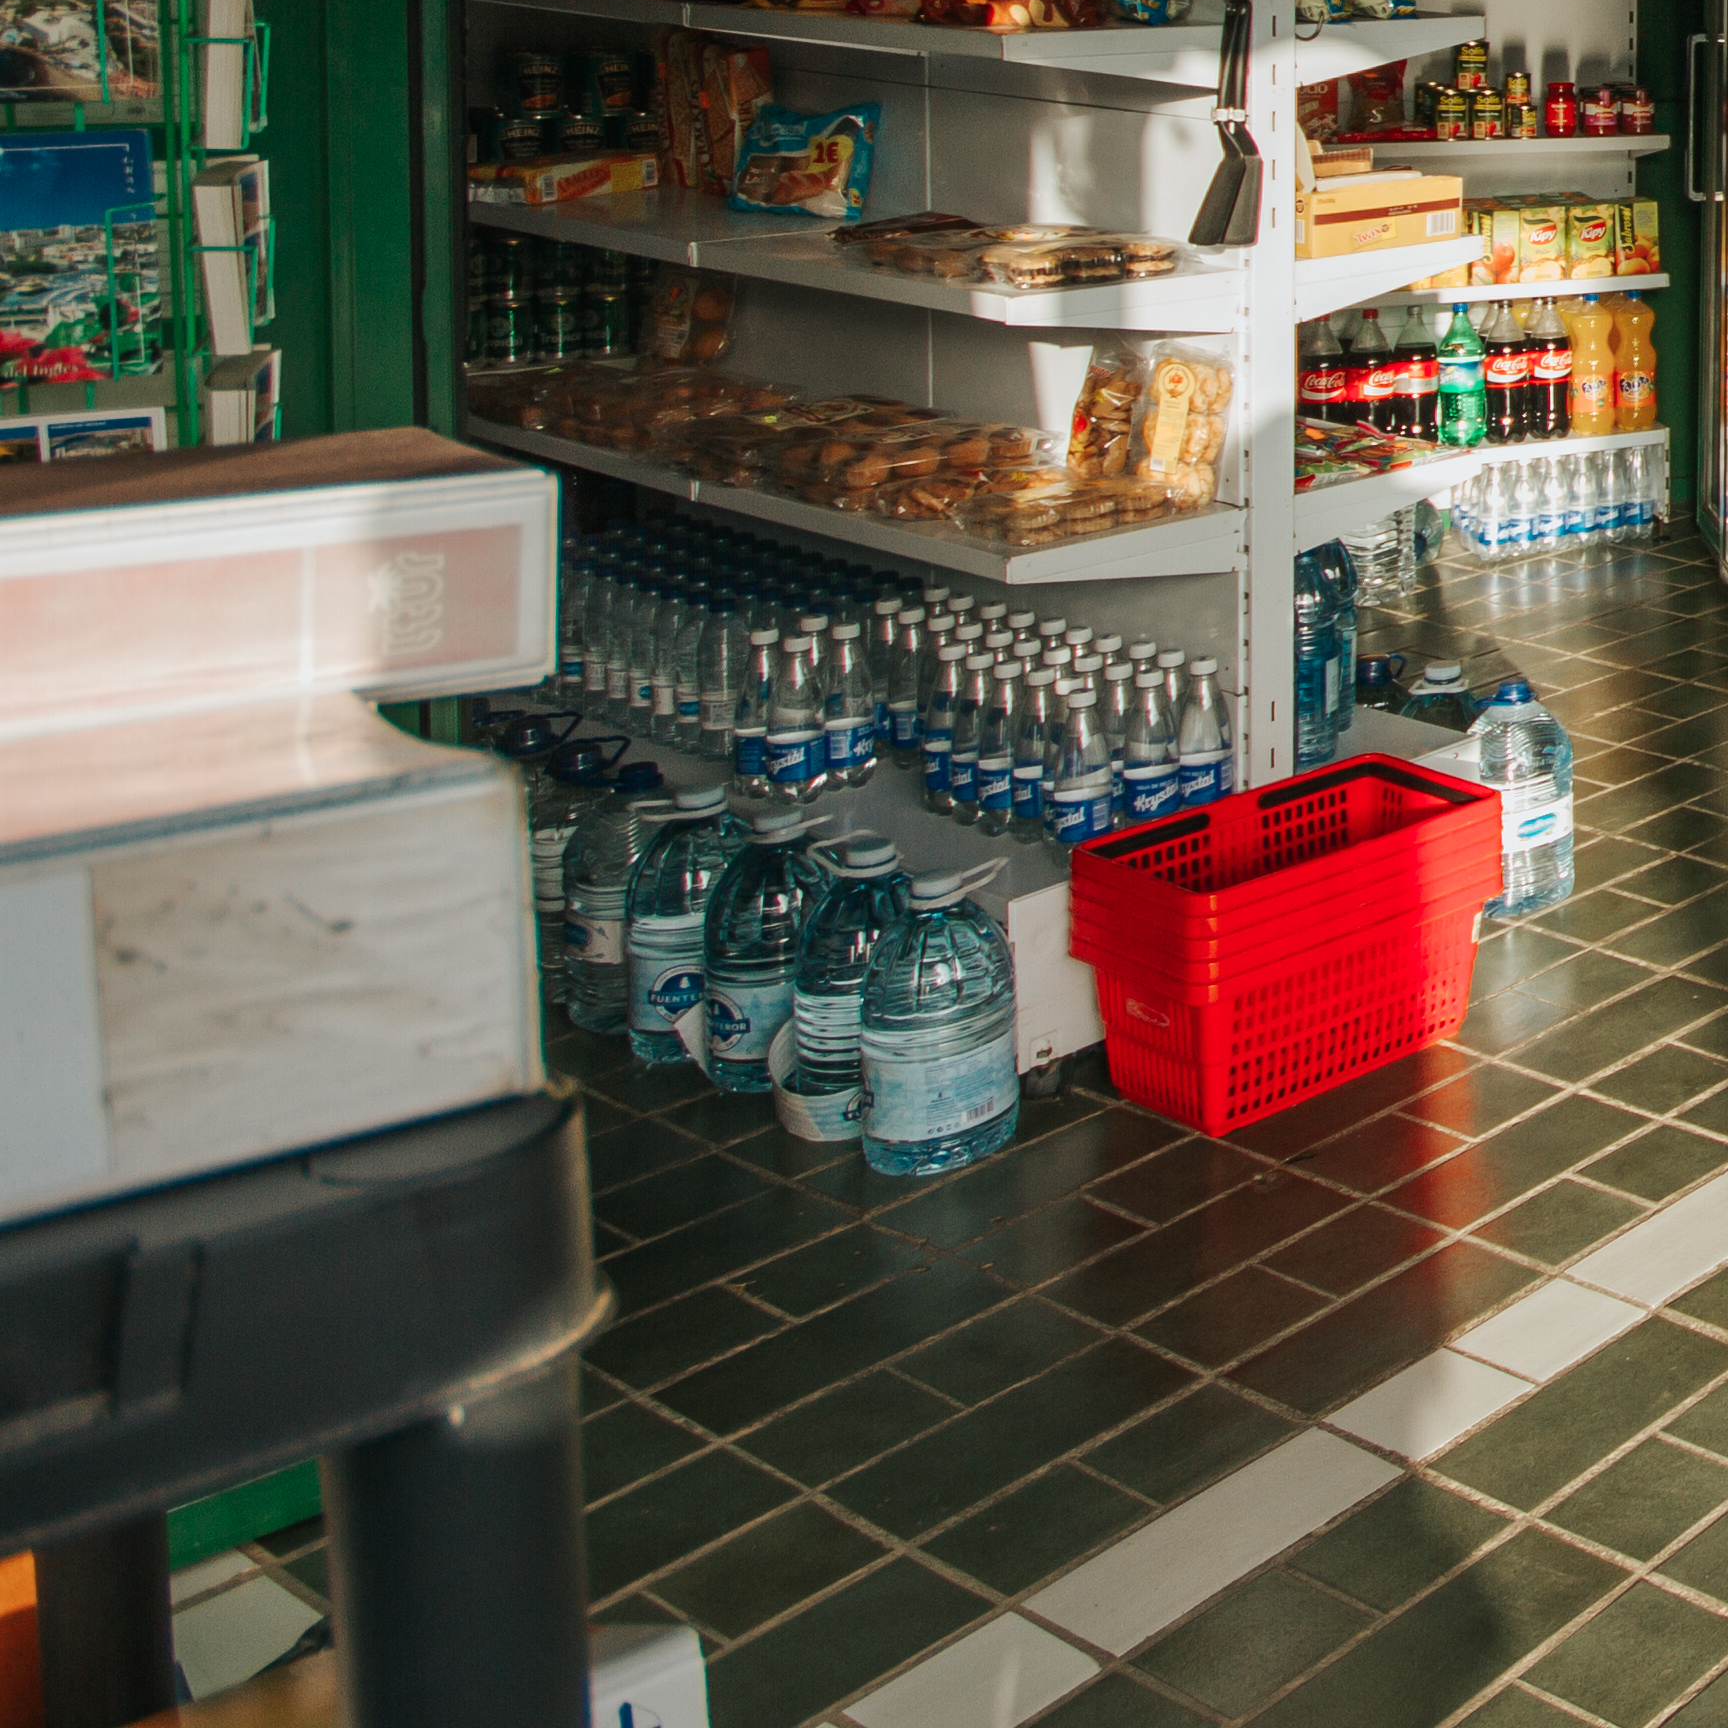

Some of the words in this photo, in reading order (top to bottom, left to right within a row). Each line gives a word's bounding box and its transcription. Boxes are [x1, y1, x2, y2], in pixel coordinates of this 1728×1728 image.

[523, 62, 559, 75] HEINZ
[507, 127, 540, 139] HEINZ
[566, 125, 600, 137] HEINZ
[1354, 227, 1382, 246] Twix
[1529, 228, 1557, 243] Kipy
[1580, 226, 1606, 240] Kipy
[1619, 376, 1650, 393] Fanta
[1133, 783, 1179, 812] Krystal
